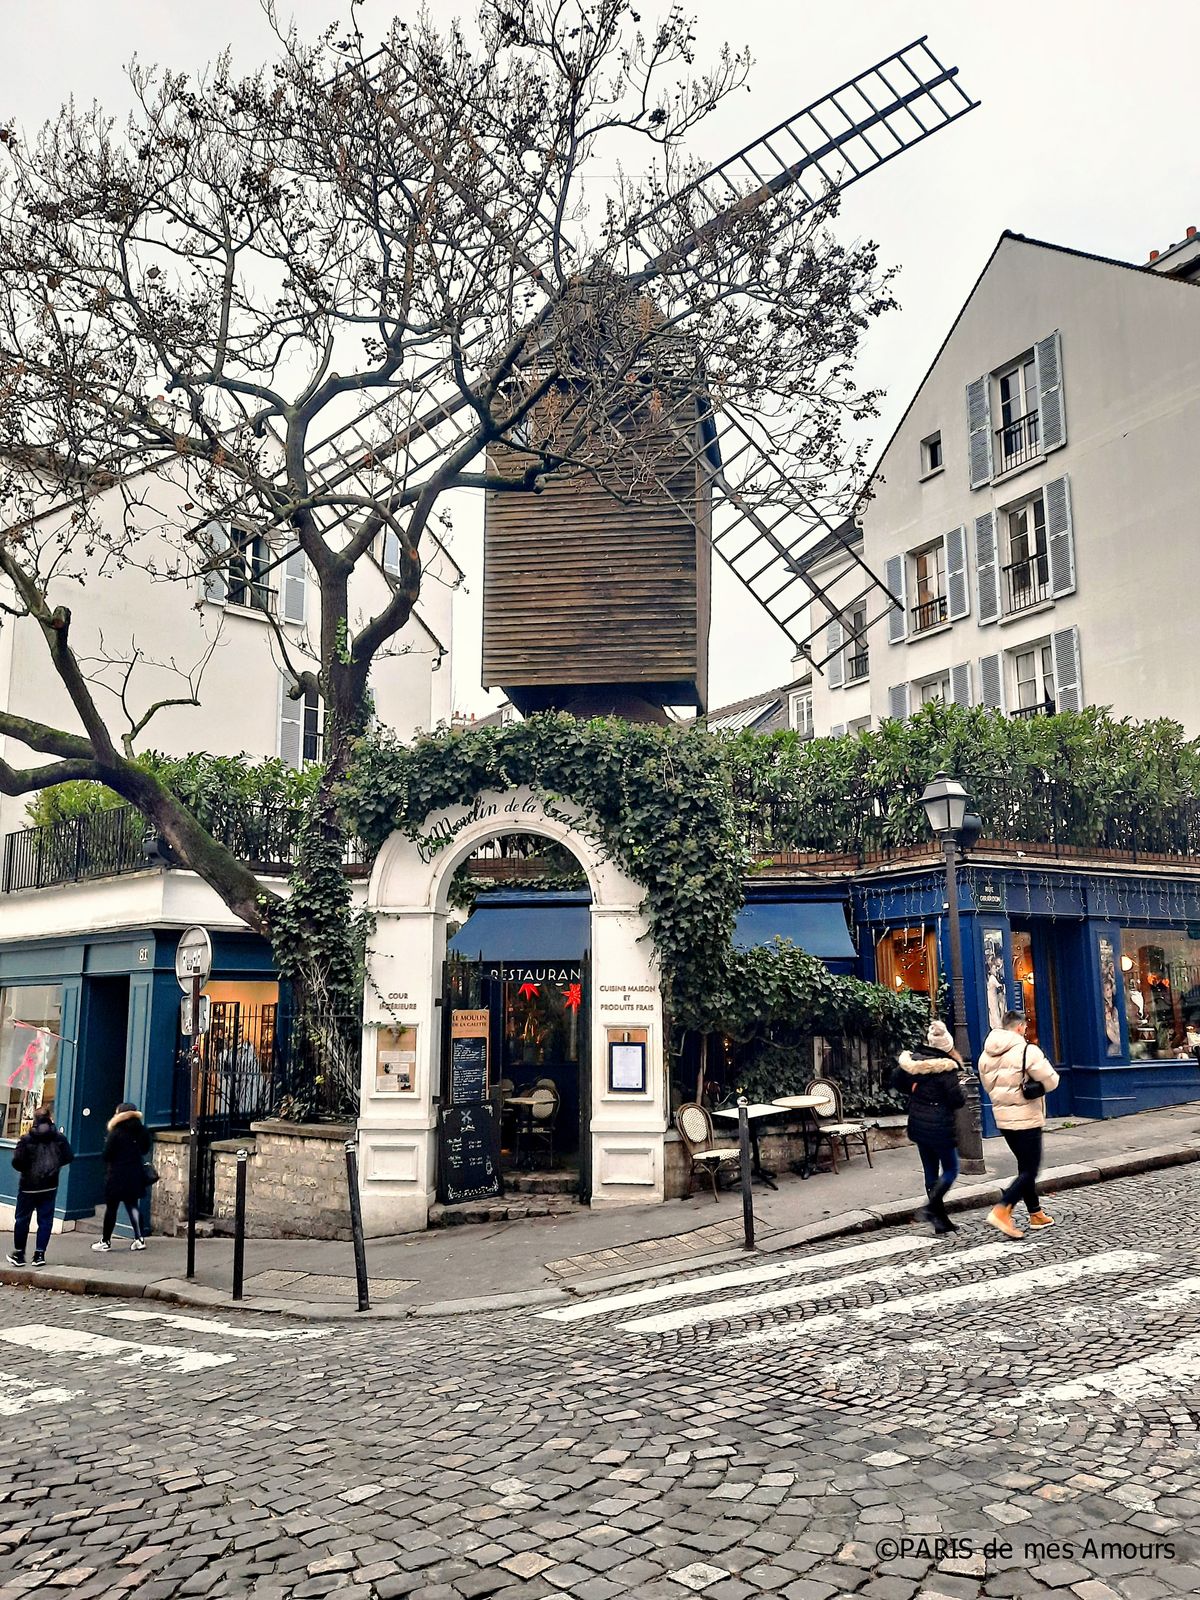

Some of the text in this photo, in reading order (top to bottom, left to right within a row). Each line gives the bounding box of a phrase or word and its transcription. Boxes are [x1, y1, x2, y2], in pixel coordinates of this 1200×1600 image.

[504, 797, 520, 813] de
[521, 796, 537, 814] la
[628, 985, 656, 993] MAISON
[388, 992, 409, 1000] COUR
